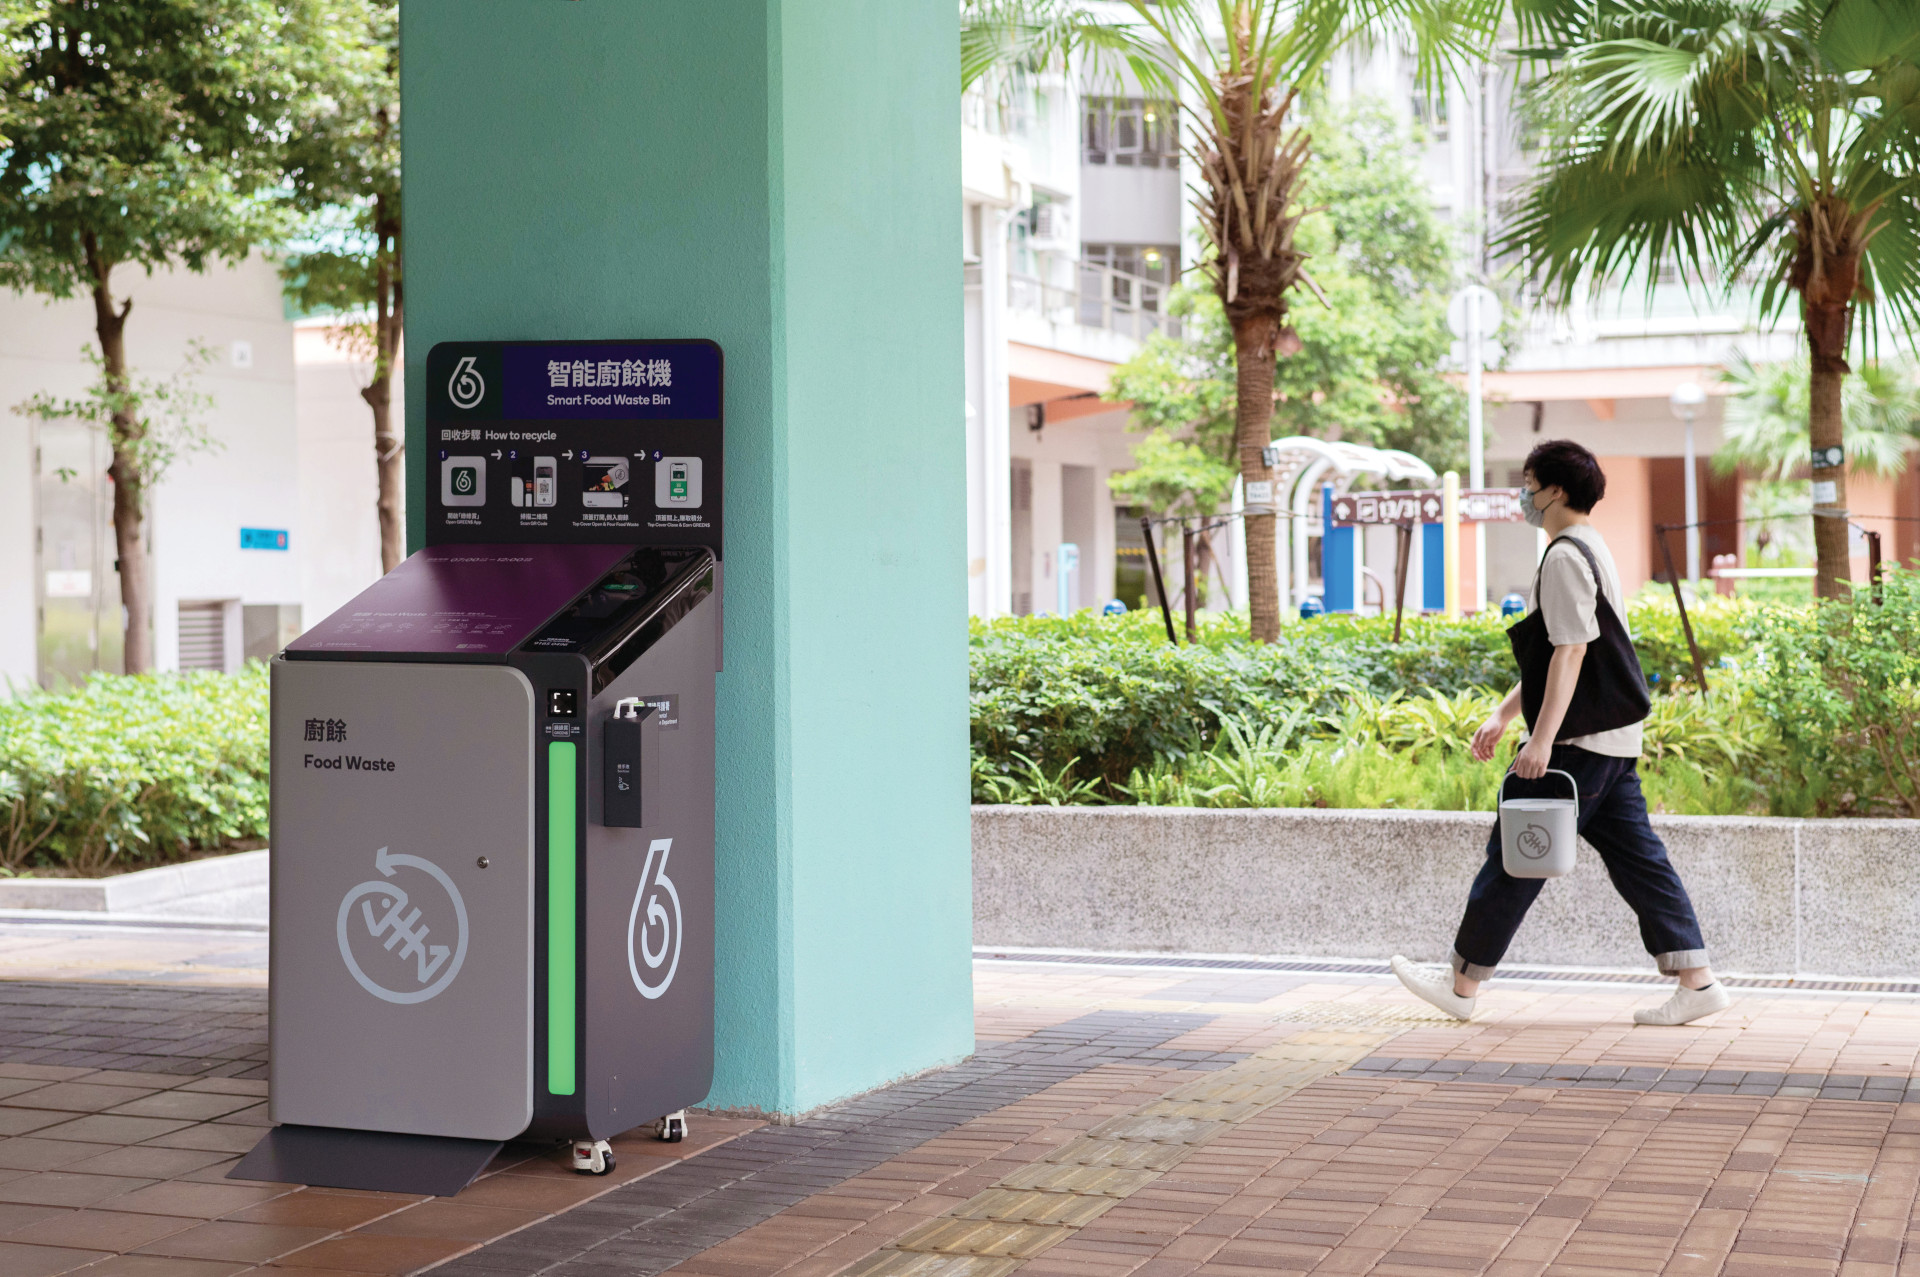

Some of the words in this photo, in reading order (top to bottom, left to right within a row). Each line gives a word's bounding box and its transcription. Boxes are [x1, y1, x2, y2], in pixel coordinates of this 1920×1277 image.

[547, 359, 672, 388] 智能廚餘機
[547, 395, 581, 406] Smart
[584, 394, 612, 406] Food
[614, 394, 650, 406] Waste
[652, 394, 671, 405] Bin
[441, 430, 481, 441] 回收步驟
[485, 430, 506, 440] How
[509, 431, 520, 440] to
[522, 430, 556, 442] recycle
[304, 718, 347, 742] 廚餘
[304, 754, 342, 770] Food
[346, 756, 395, 772] Waste
